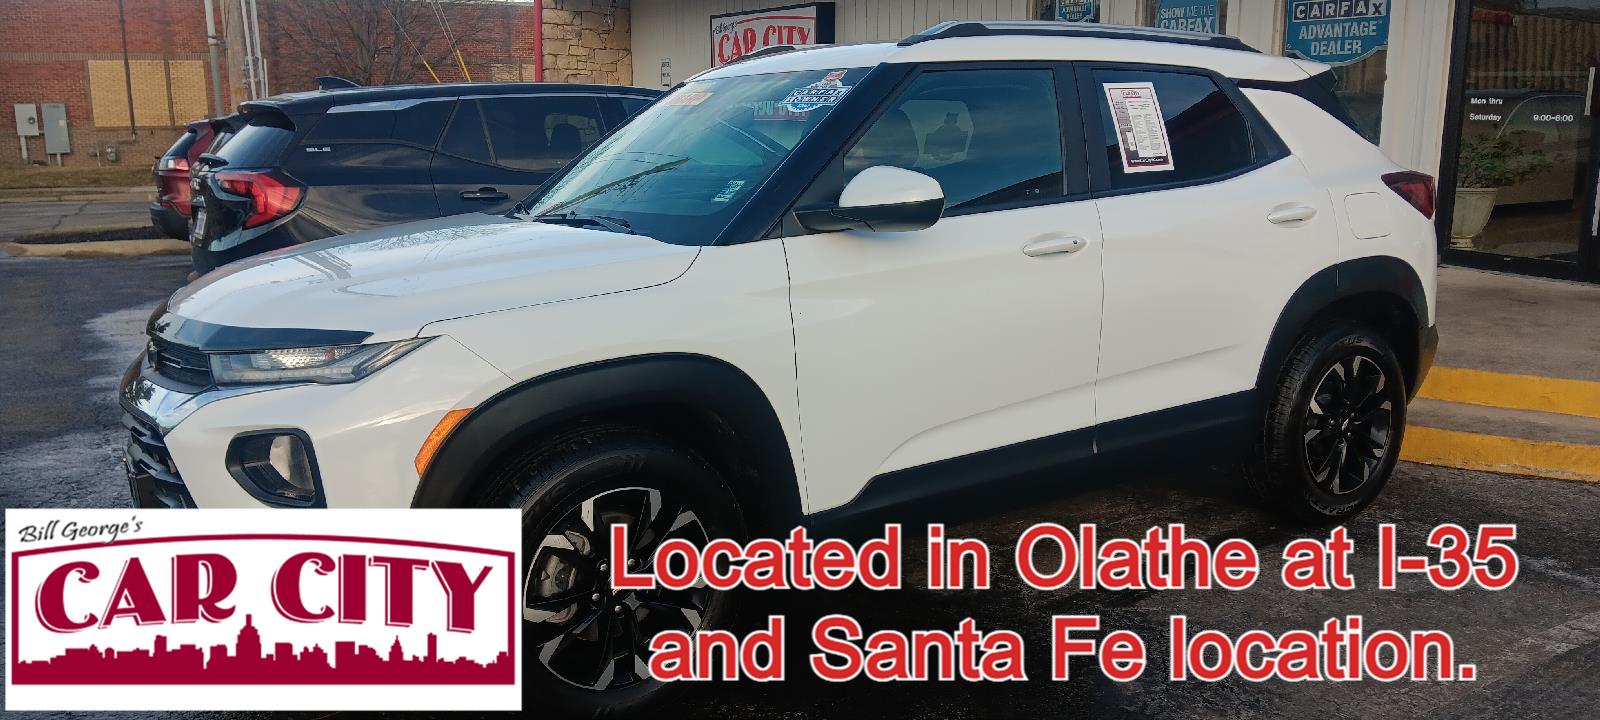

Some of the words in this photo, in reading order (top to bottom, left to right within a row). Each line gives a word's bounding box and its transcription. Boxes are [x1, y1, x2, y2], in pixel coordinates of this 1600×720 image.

[1160, 7, 1185, 19] SHOW
[1199, 4, 1215, 16] THE
[1296, 1, 1385, 18] CARFAX
[1160, 16, 1215, 34] CARFAX
[1298, 20, 1377, 39] ADVANTAGE
[718, 28, 757, 64] CAR
[763, 25, 811, 47] CITY
[1310, 39, 1361, 55] DEALER
[1469, 113, 1502, 122] Saturday
